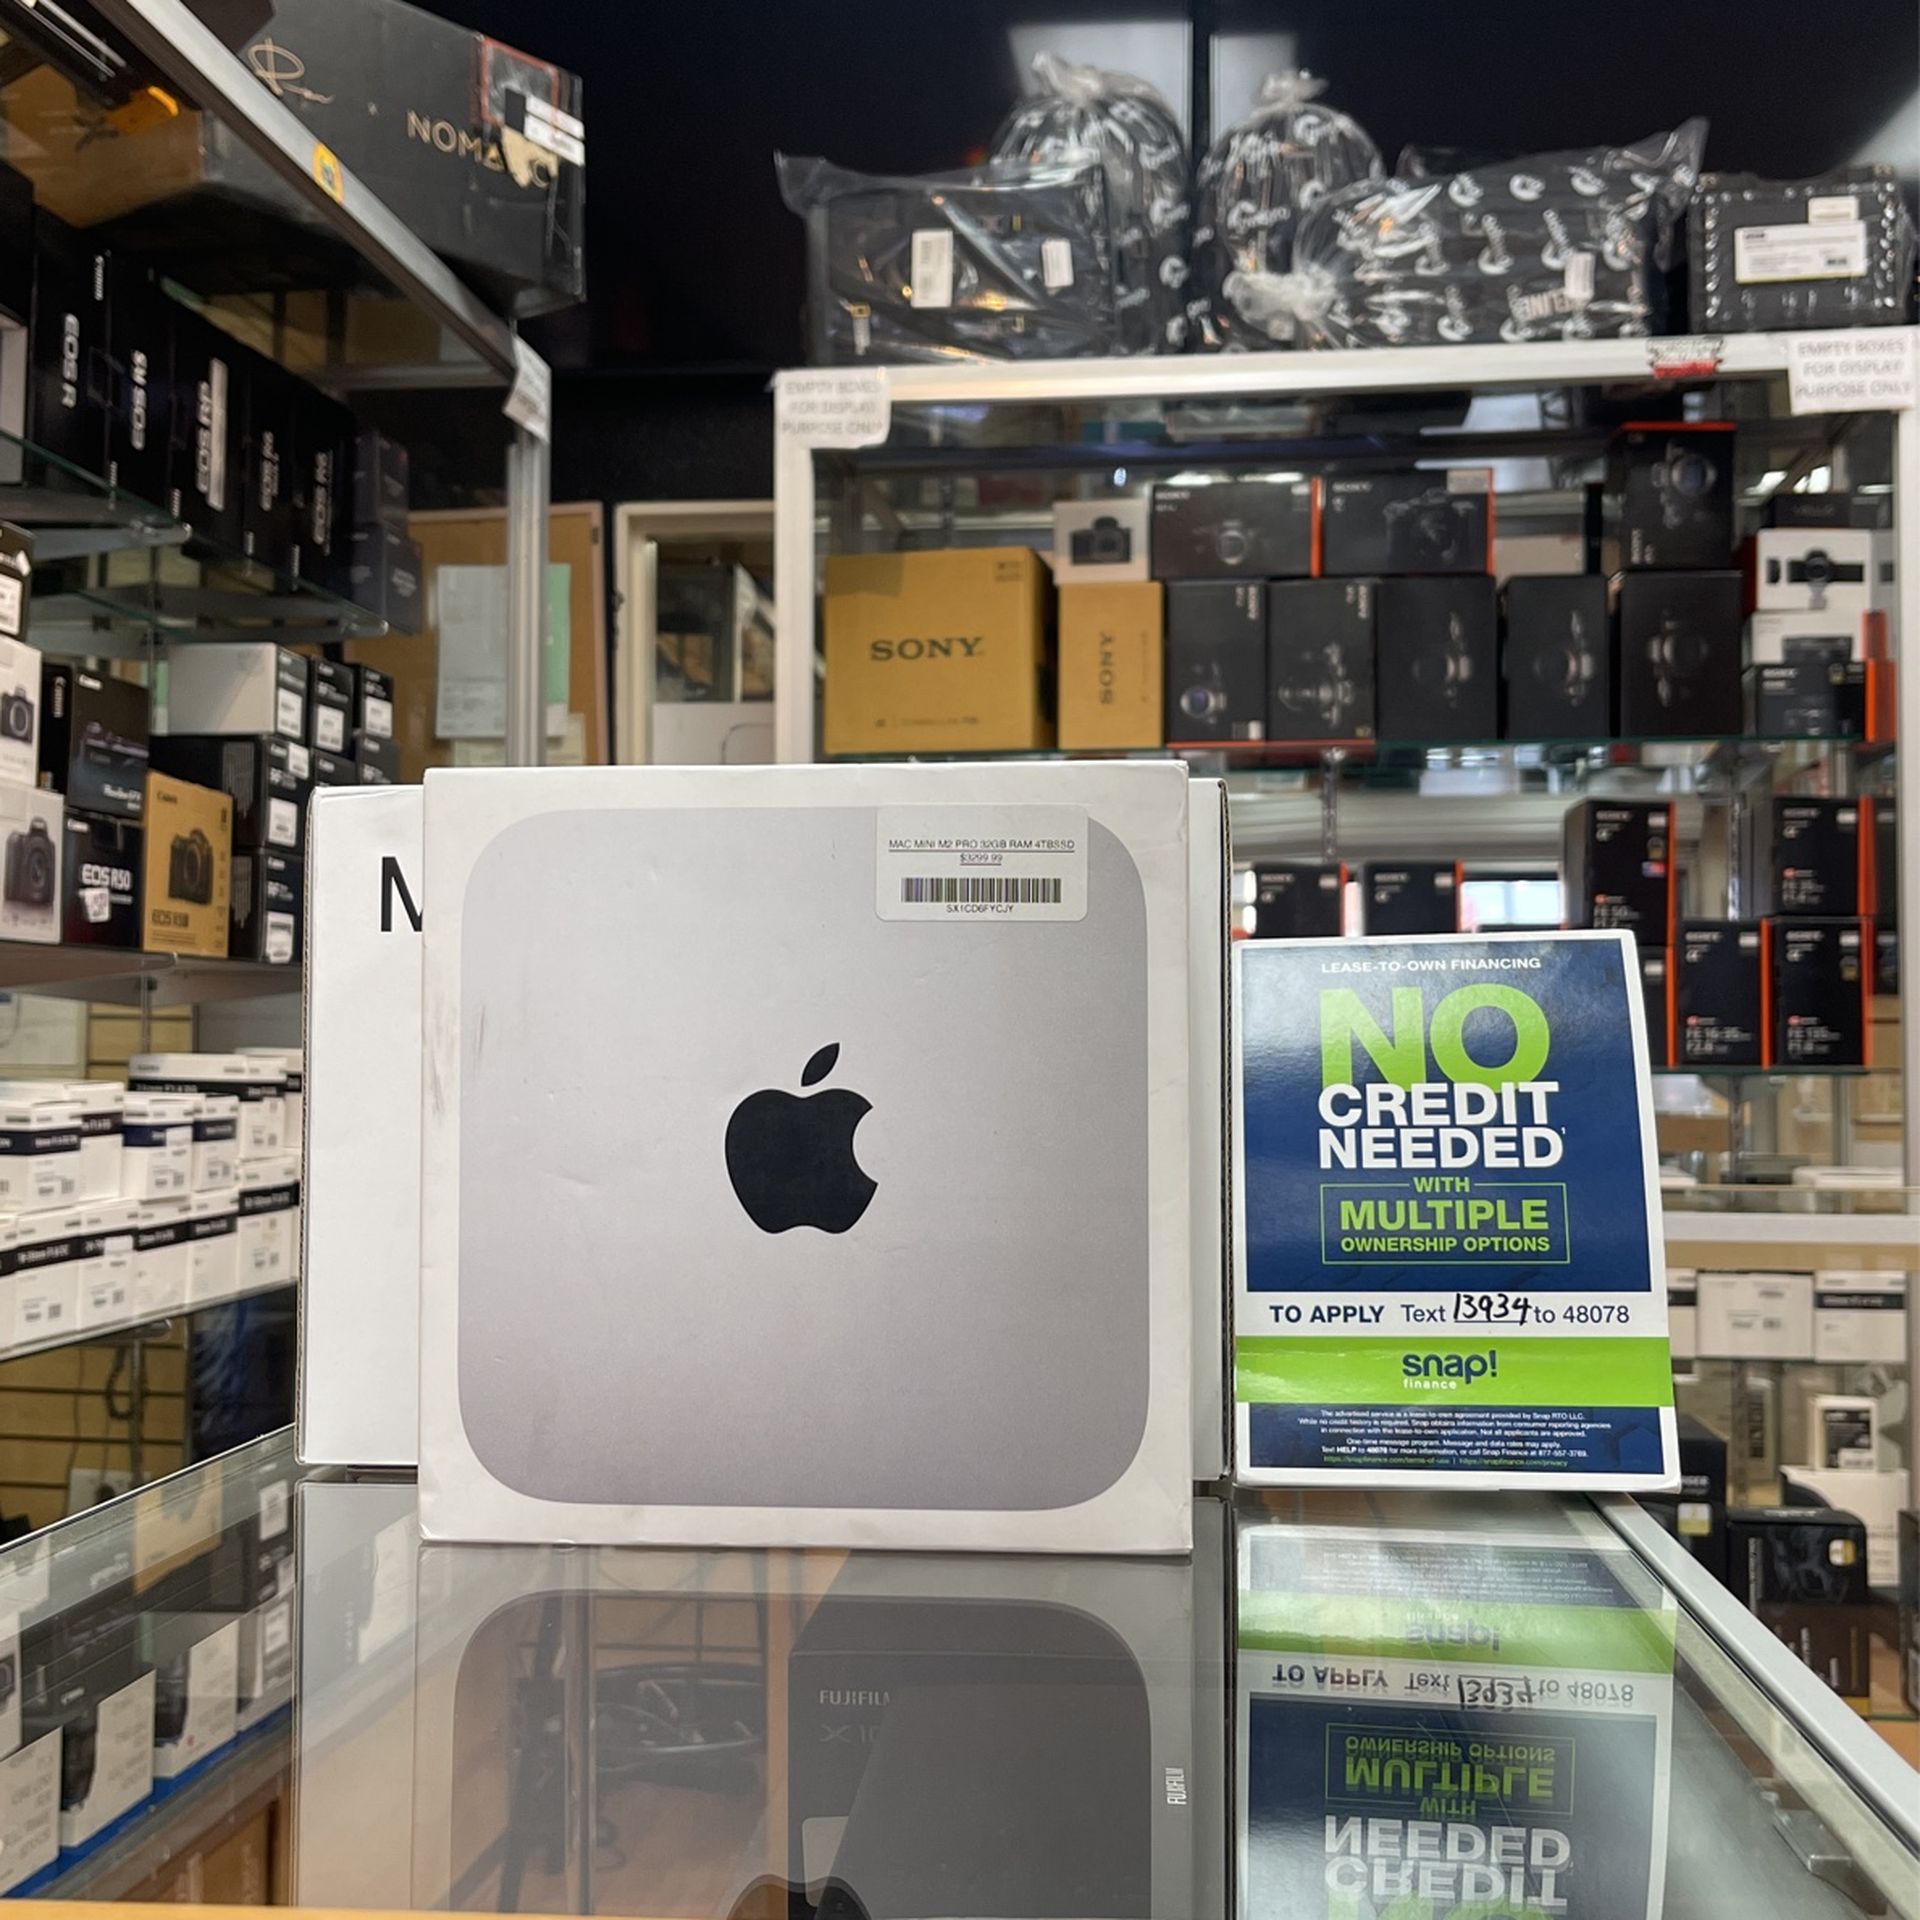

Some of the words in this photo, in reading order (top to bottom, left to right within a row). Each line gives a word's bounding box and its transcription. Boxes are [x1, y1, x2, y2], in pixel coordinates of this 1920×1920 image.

[871, 636, 985, 662] SONY
[1099, 632, 1116, 704] SONY
[888, 840, 912, 850] MAC
[914, 840, 936, 850] MINI
[938, 840, 953, 850] M2
[955, 840, 977, 850] PRO
[1009, 840, 1033, 850] RAM
[81, 863, 109, 887] EOS
[110, 867, 133, 891] R50
[1321, 960, 1447, 974] LEASE-TO-OWN
[1451, 957, 1542, 971] FINANCING
[1319, 982, 1550, 1093] NO
[1318, 1081, 1560, 1127] CREDIT
[1413, 1176, 1470, 1193] WITH
[1340, 1199, 1550, 1231] MULTIPLE
[1340, 1237, 1458, 1253] OWNERSHIP
[1463, 1236, 1551, 1252] OPTIONS
[1269, 1305, 1302, 1323] TO
[1309, 1305, 1385, 1324] APPLY
[1400, 1304, 1447, 1324] Text
[1452, 1292, 1533, 1326] 13934
[1534, 1306, 1556, 1324] to
[1562, 1305, 1631, 1324] 48078
[1402, 1350, 1498, 1385] snap!
[1403, 1378, 1458, 1390] finance
